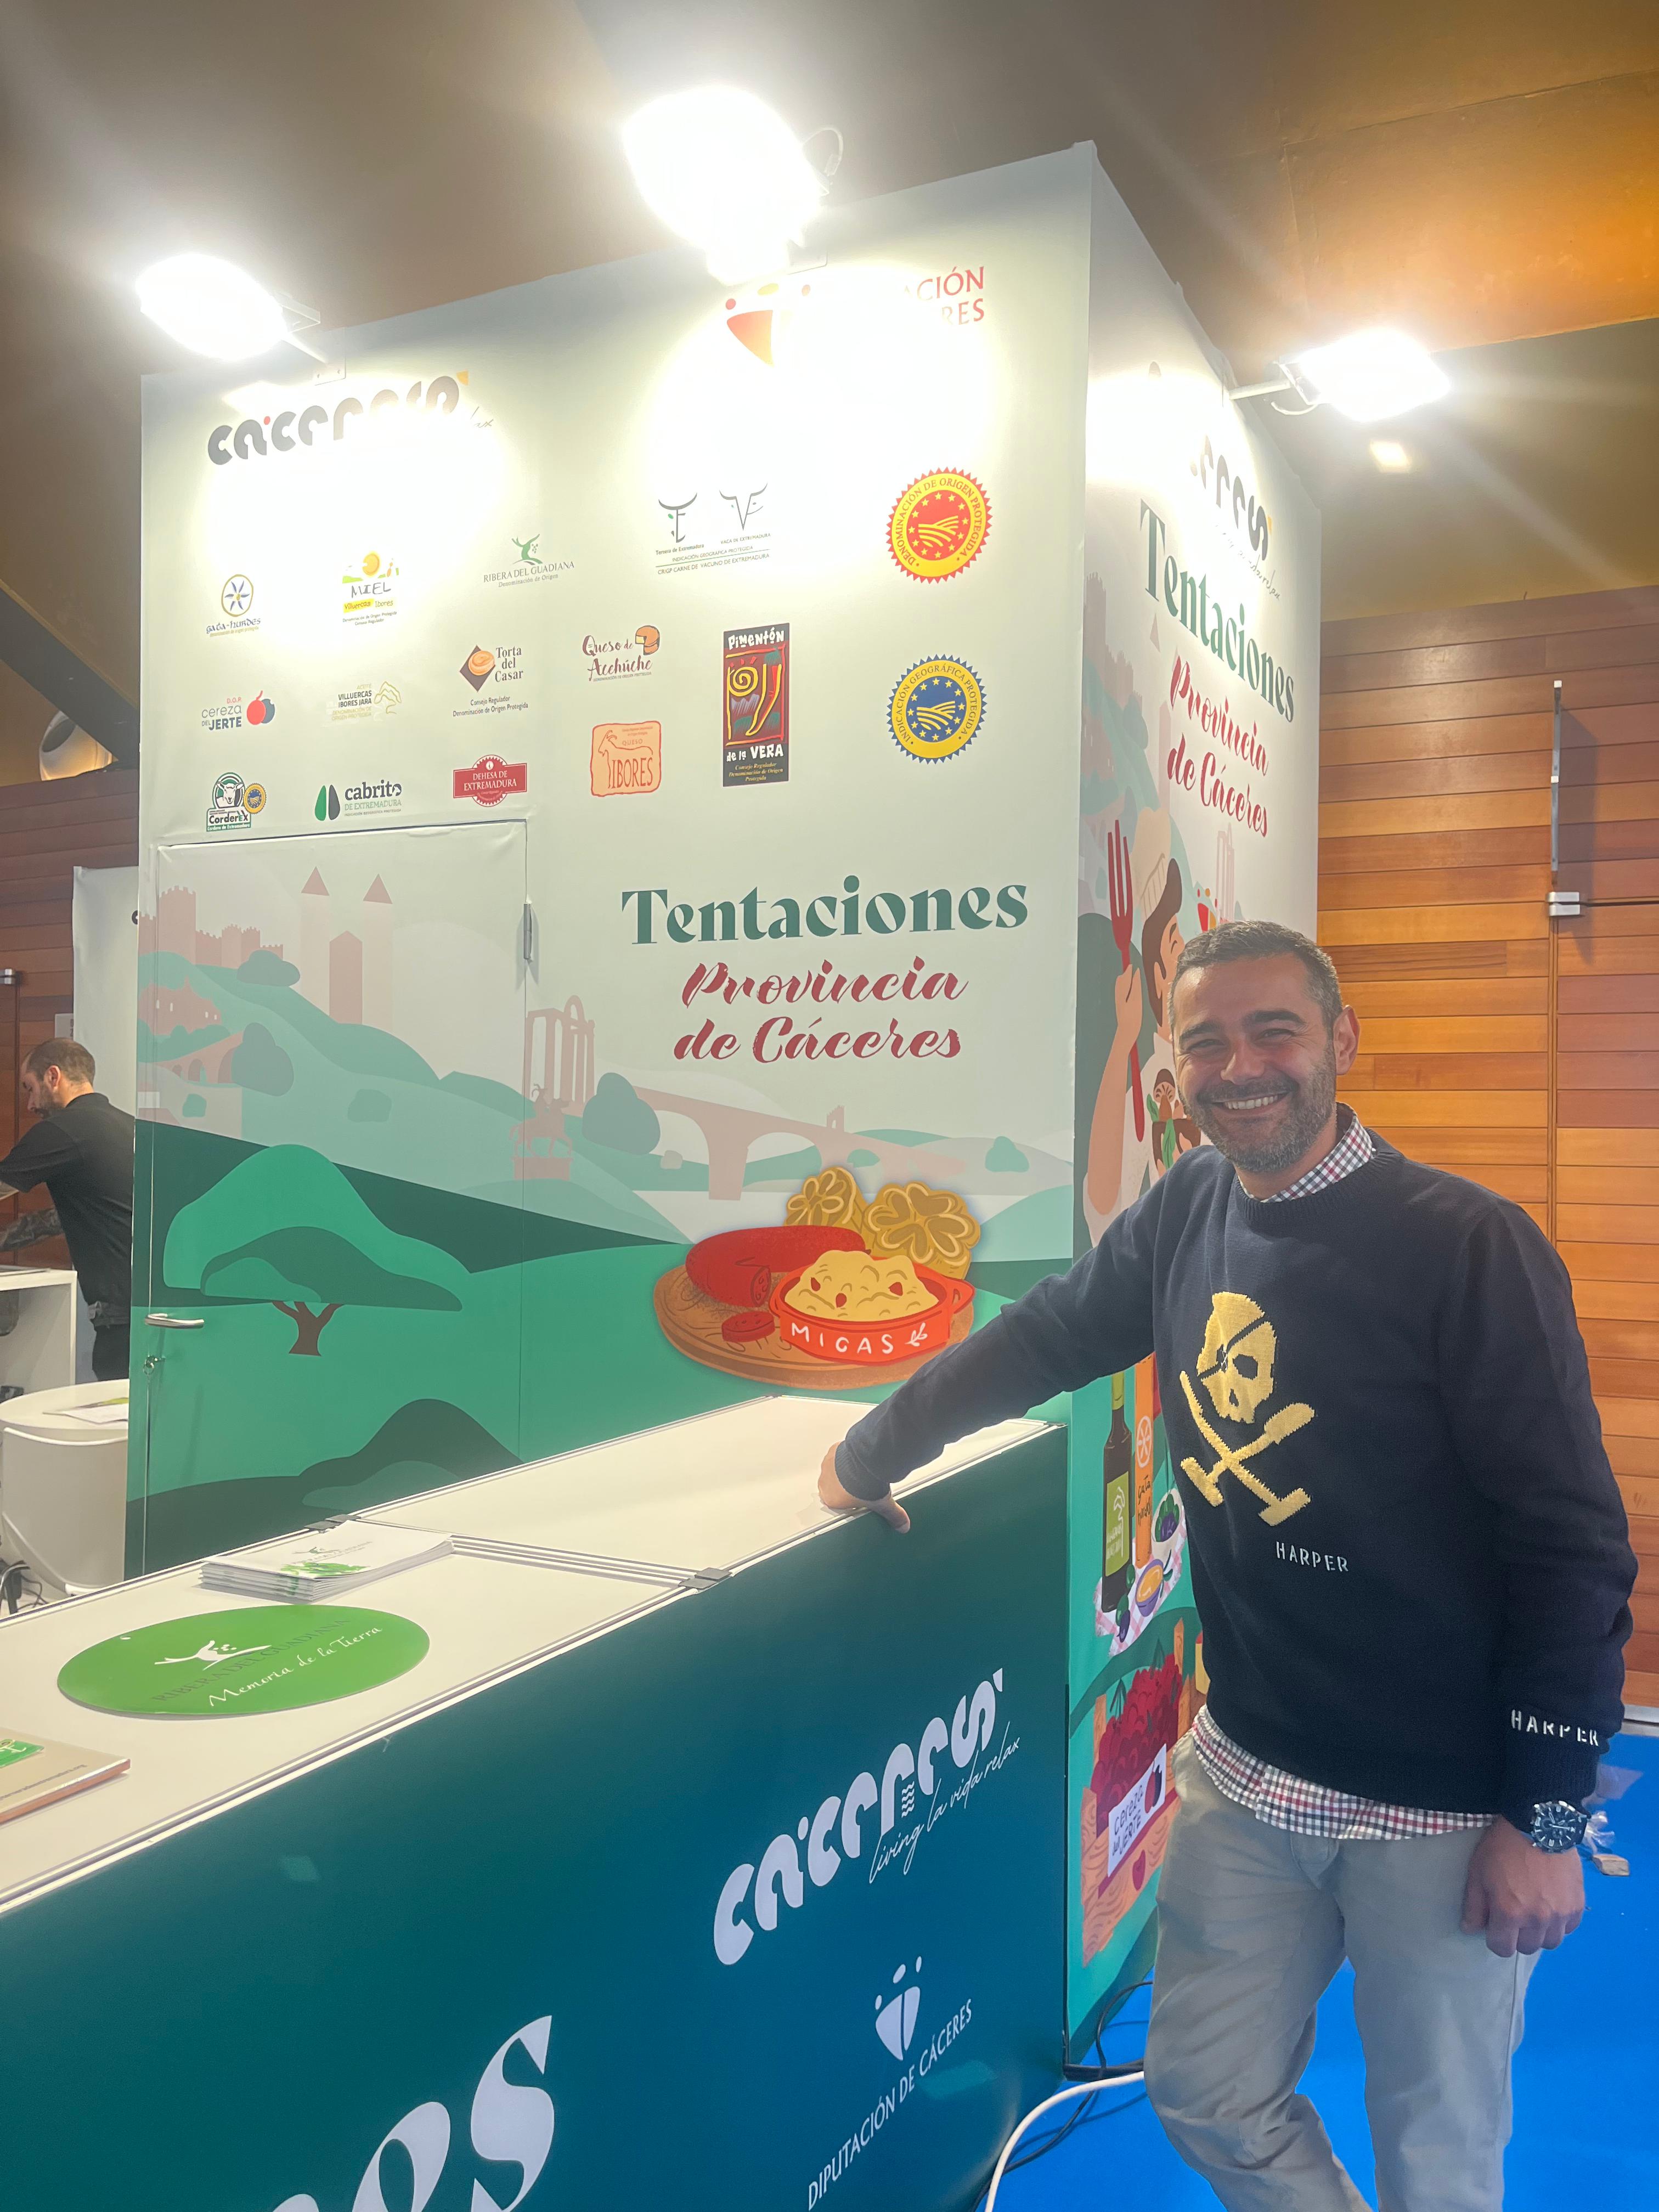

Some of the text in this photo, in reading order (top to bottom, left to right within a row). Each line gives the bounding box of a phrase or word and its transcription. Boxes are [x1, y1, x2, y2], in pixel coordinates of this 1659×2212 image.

[895, 477, 982, 566] DENOMINACIÓN DE ORIGEN PROTEGIDA
[700, 560, 723, 568] VACUNO
[732, 553, 770, 563] EXTREMADURA
[483, 561, 575, 583] RIBERA DEL GUADIANA
[498, 576, 534, 588] Denominación
[351, 582, 391, 599] MIEL
[1140, 498, 1294, 723] Tentaciones
[496, 646, 522, 658] Torta
[582, 635, 634, 657] Queso de
[501, 657, 516, 669] del
[495, 669, 523, 682] Casar
[338, 690, 372, 701] VILLUERCAS
[359, 698, 372, 706] JARA
[488, 695, 511, 704] Regulador
[507, 702, 529, 710] Protegida
[895, 663, 977, 742] INDICACIÓN GEOGRÁFICA PROTEGIDA
[201, 705, 242, 718] cereza
[1170, 654, 1269, 776] Provincia
[208, 716, 242, 731] JERTE
[726, 743, 784, 762] de la VERA
[472, 770, 508, 781] DEHESA DE
[611, 756, 653, 789] IBORES
[345, 779, 402, 800] cabrito
[464, 778, 517, 792] EXTREMADURA
[1167, 732, 1267, 837] de Cáceres
[354, 799, 402, 810] EXTREMADURA
[621, 874, 1029, 945] Tentaciones
[681, 955, 969, 1009] Provincia
[673, 1015, 961, 1064] de Cáceres
[790, 1322, 894, 1356] MIGAS
[1275, 1541, 1349, 1572] HARPER
[153, 1619, 351, 1702] RIBERA DEL GUADIANA
[208, 1626, 382, 1707] Memoria de la Tierra
[1511, 1709, 1599, 1747] HARPER
[869, 1721, 1020, 1884] living la vida relax
[1114, 1785, 1144, 1836] cereza
[1120, 1809, 1141, 1855] JERTE
[809, 1999, 972, 2211] DIPUTACIÓN DE CÁCERES
